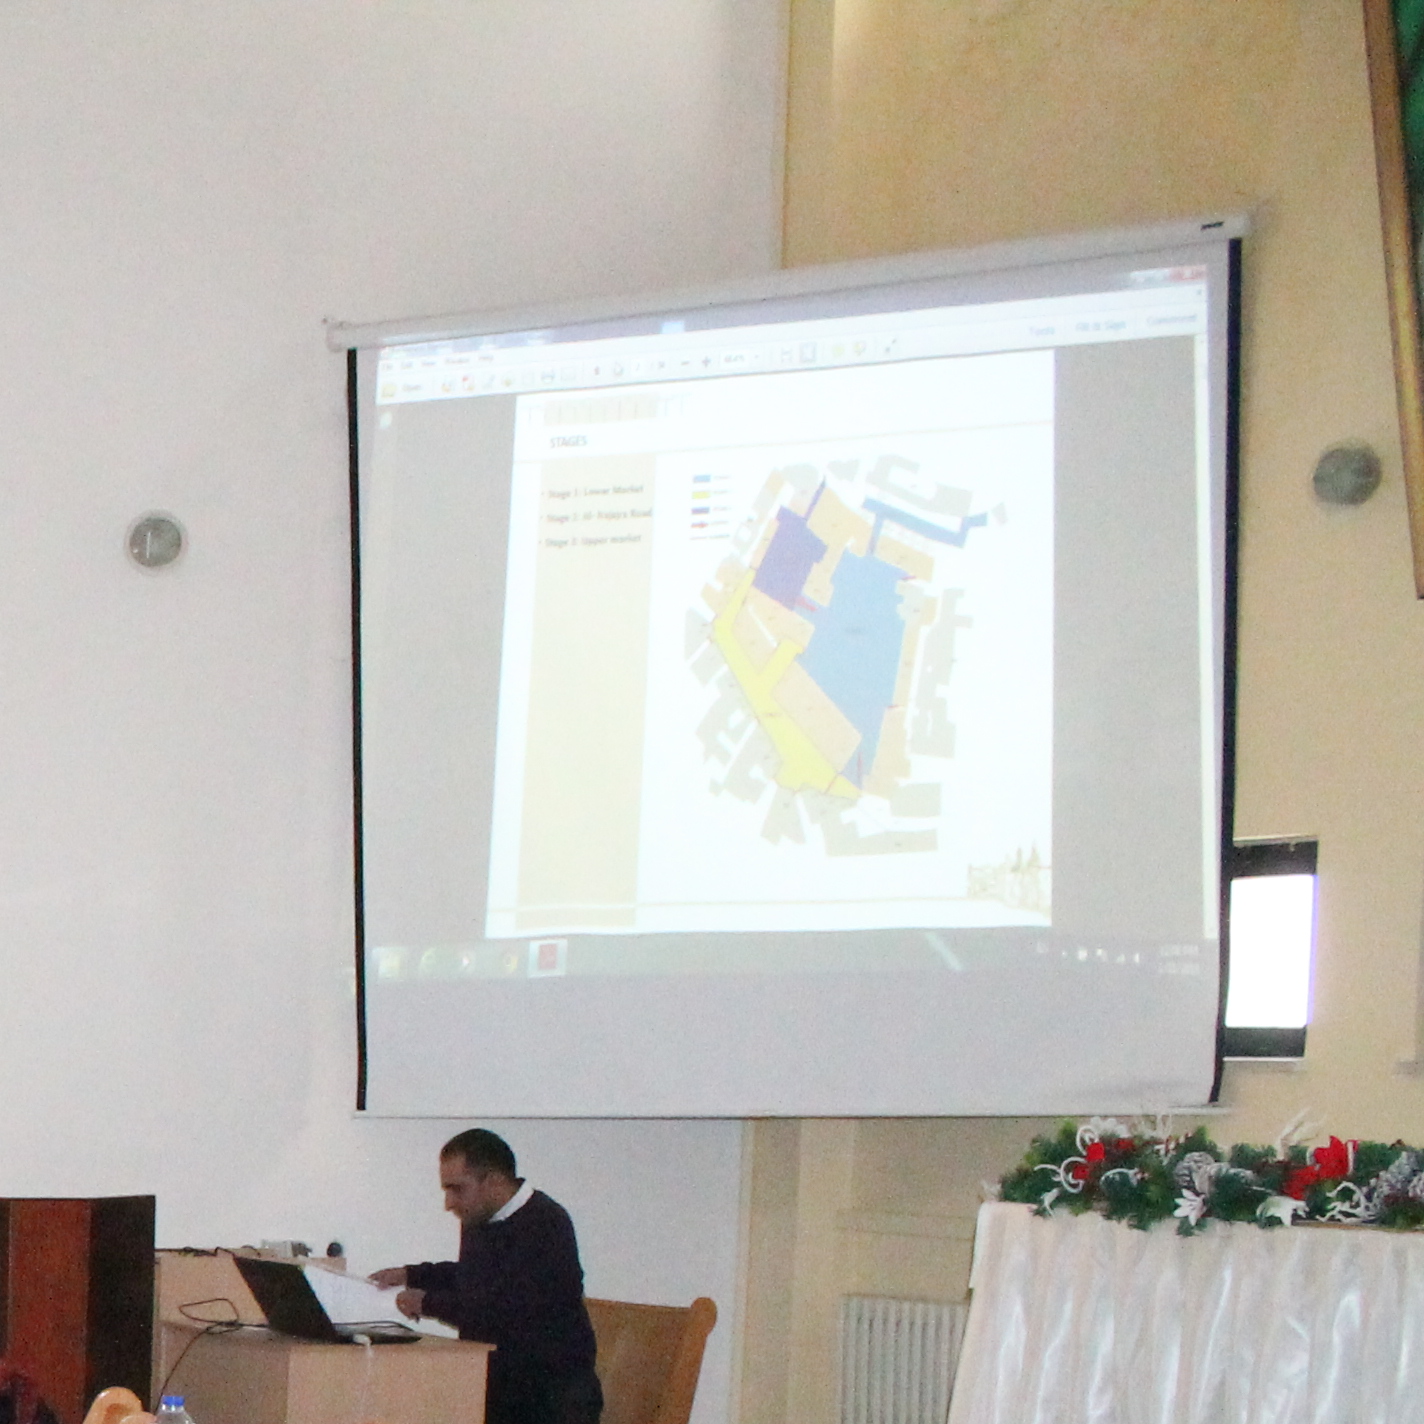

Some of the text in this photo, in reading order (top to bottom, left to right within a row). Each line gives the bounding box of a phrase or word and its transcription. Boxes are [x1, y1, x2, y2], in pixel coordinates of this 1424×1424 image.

[549, 434, 589, 449] STAGES
[548, 490, 571, 501] Stage
[546, 514, 570, 526] Stage
[545, 538, 569, 550] Stage
